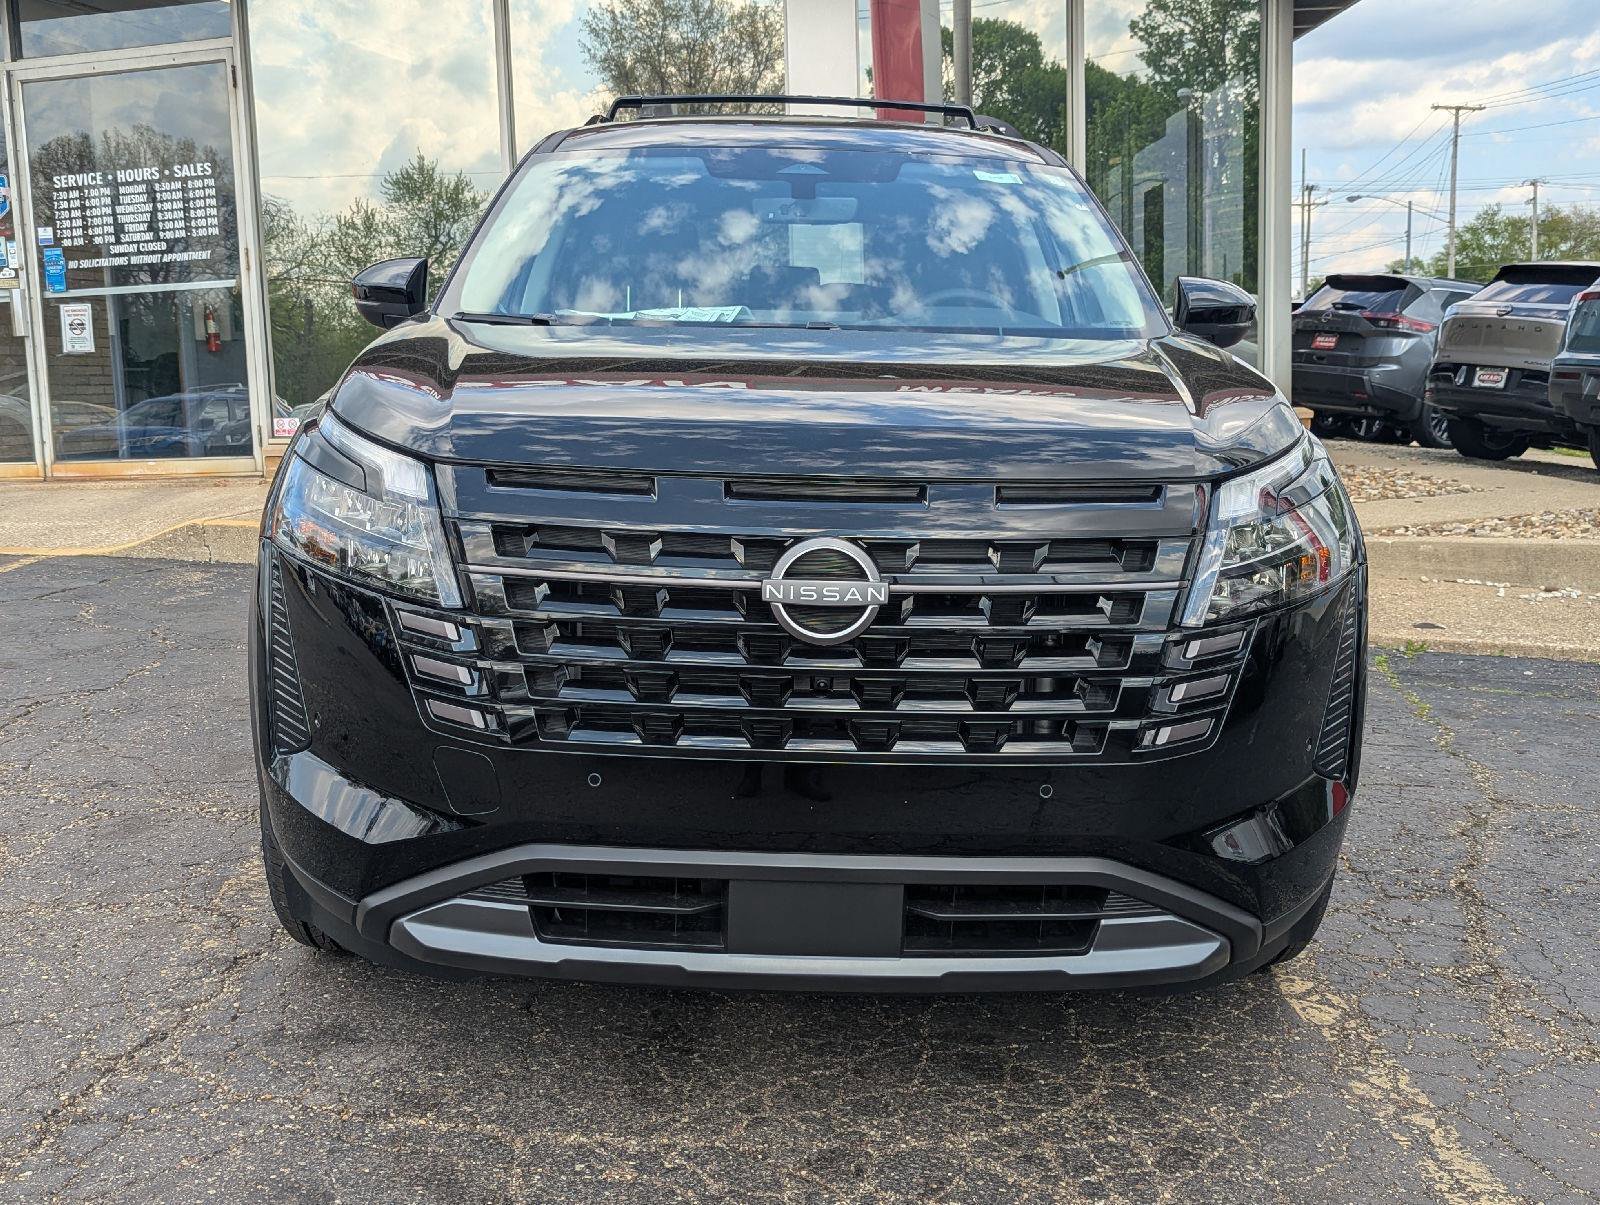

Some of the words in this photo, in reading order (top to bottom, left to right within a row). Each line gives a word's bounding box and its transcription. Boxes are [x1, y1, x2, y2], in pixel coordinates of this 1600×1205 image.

[52, 172, 103, 188] SERVICE
[116, 167, 159, 182] HOURS
[173, 162, 212, 177] SALES
[52, 191, 67, 199] 7:30
[68, 189, 79, 198] AM
[99, 187, 110, 195] PM
[118, 184, 146, 194] MONDAY
[154, 182, 170, 191] 8:30
[170, 180, 181, 189] AM
[187, 179, 202, 188] 8:00
[203, 178, 214, 186] PM
[53, 200, 68, 209] 7:30
[69, 199, 80, 207] AM
[84, 197, 99, 206] 6:00
[100, 196, 111, 205] PM
[119, 193, 147, 203] TUESDAY
[155, 191, 171, 200] 9:00
[171, 190, 182, 199] AM
[188, 189, 203, 198] 6:00
[205, 187, 215, 196] PM
[54, 210, 69, 218] 7:30
[70, 209, 81, 217] AM
[85, 207, 100, 216] 6:00
[101, 206, 112, 214] PM
[115, 202, 153, 213] WEDNESDAY
[156, 201, 172, 210] 9:00
[172, 200, 183, 209] AM
[189, 198, 204, 207] 6:00
[205, 197, 216, 206] PM
[55, 219, 70, 228] 7:30
[71, 218, 82, 227] AM
[87, 216, 101, 225] 7:00
[102, 215, 113, 224] PM
[116, 212, 151, 223] THURSDAY
[156, 211, 172, 220] 8:30
[172, 210, 184, 218] AM
[189, 208, 205, 217] 8:00
[206, 207, 217, 216] PM
[56, 229, 70, 237] 7:30
[72, 228, 83, 236] AM
[87, 226, 102, 235] 6:00
[103, 225, 114, 233] PM
[124, 222, 148, 232] FRIDAY
[158, 220, 173, 229] 9:00
[174, 220, 184, 228] AM
[190, 218, 206, 227] 6:00
[207, 217, 218, 225] PM
[72, 237, 84, 245] AM
[104, 234, 115, 243] PM
[120, 231, 153, 242] SATURDAY
[159, 230, 174, 239] 9:00
[174, 229, 185, 237] AM
[191, 227, 207, 236] 3:00
[208, 226, 219, 234] PM
[109, 243, 137, 253] SUNDAY
[139, 241, 166, 251] CLOSED
[67, 260, 78, 269] NO
[79, 256, 128, 268] SOLICITATIONS
[130, 253, 162, 264] WITHOUT
[162, 250, 211, 262] APPOINTMENT
[1458, 322, 1543, 333] MURANO
[765, 584, 885, 602] NISSAN
